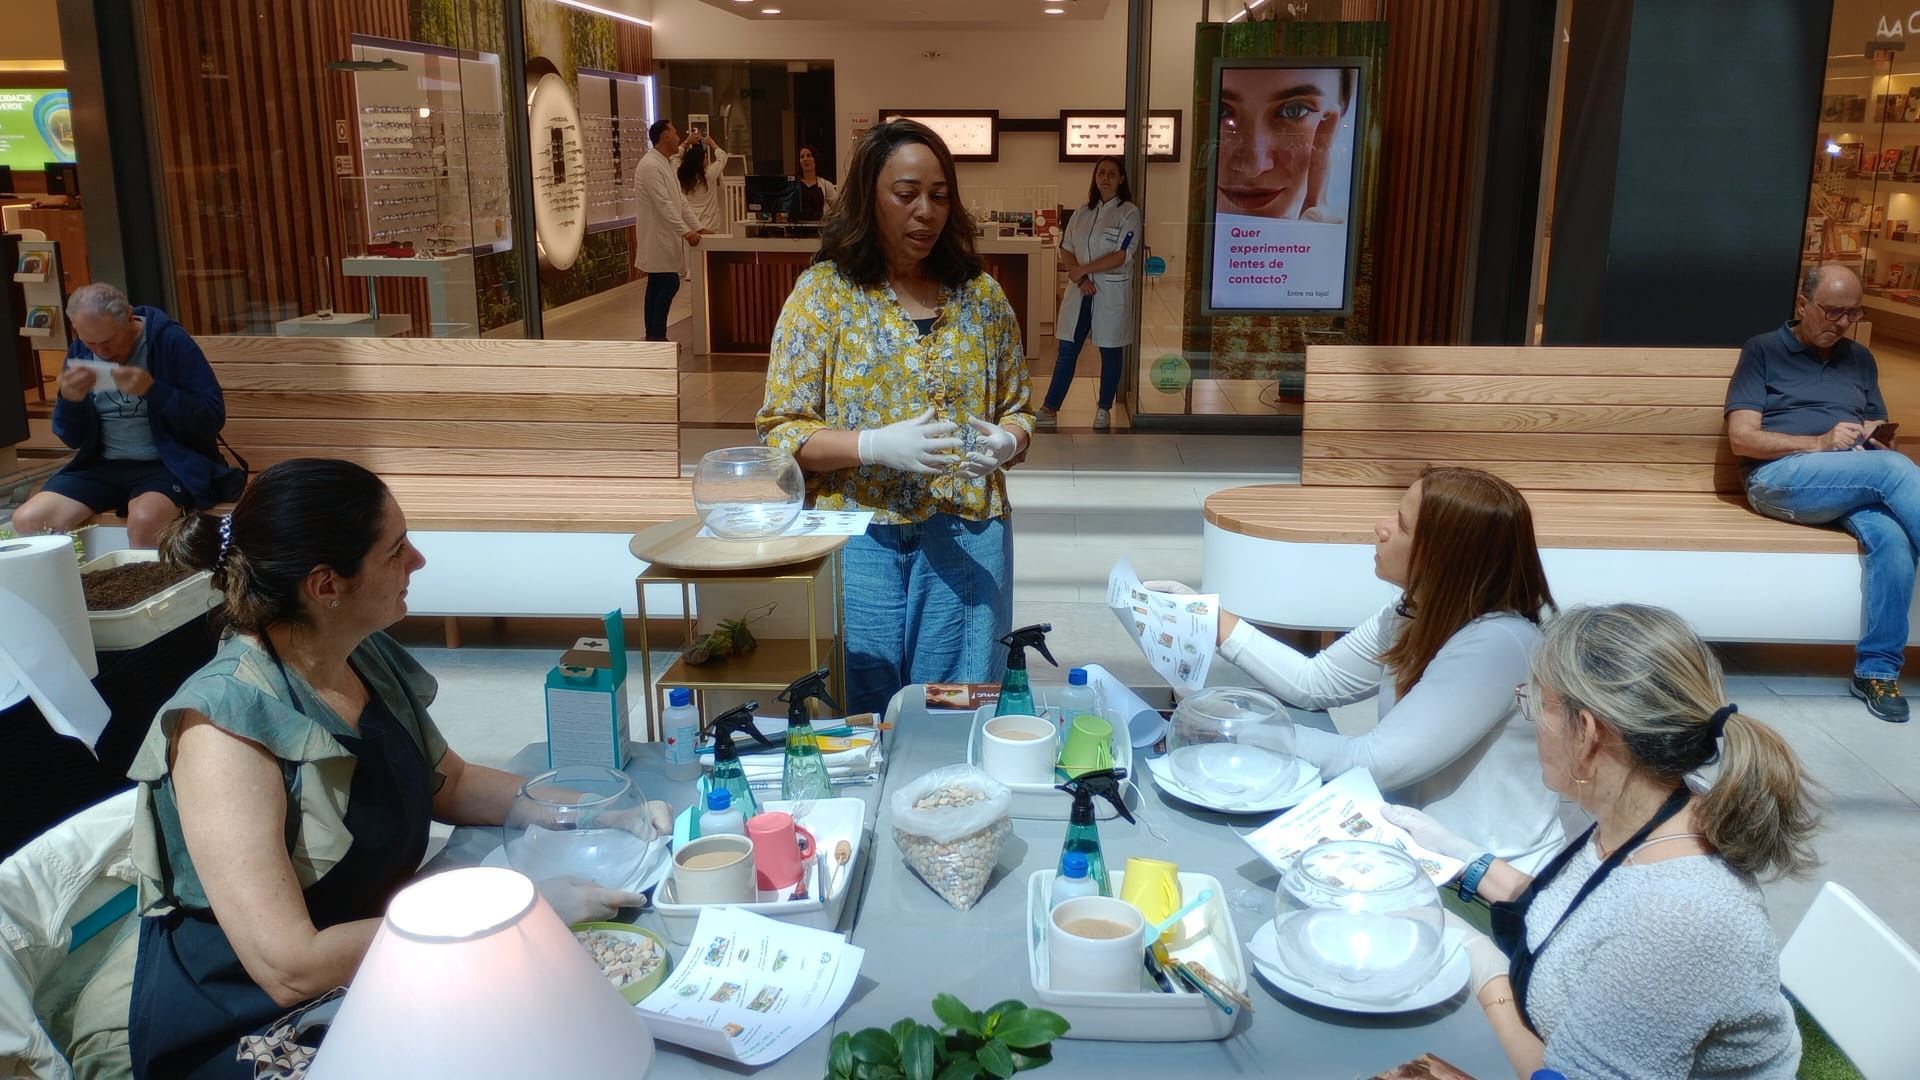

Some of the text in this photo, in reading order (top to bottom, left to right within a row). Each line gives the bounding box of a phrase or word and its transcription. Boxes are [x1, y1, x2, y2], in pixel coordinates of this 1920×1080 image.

[1230, 227, 1261, 238] Quer
[1230, 243, 1311, 255] experimentar
[1229, 258, 1284, 269] lentes de
[1228, 274, 1288, 284] contacto?
